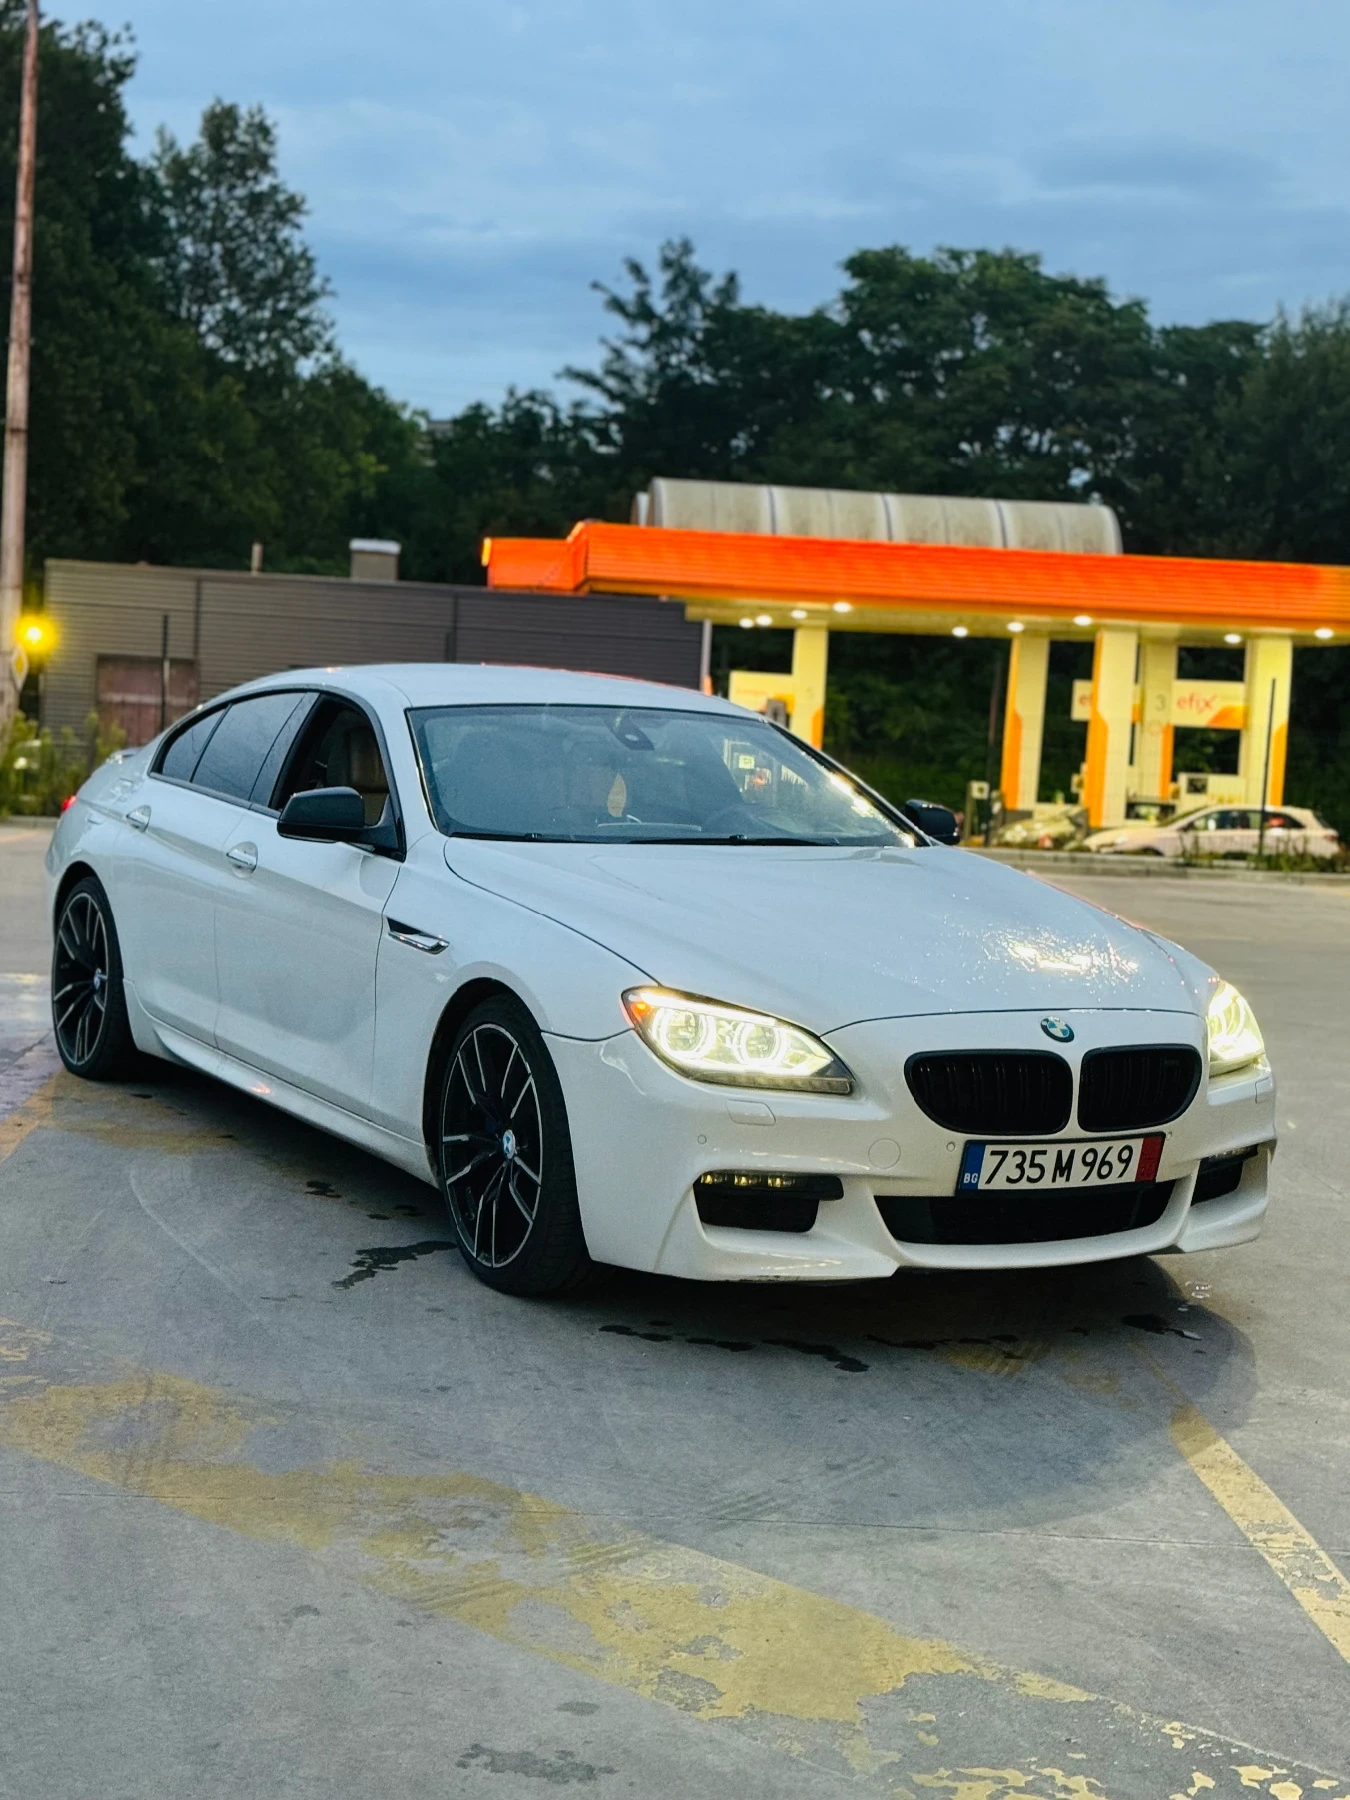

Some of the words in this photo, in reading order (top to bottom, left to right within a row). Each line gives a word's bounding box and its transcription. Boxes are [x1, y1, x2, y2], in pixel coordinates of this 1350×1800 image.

[1155, 694, 1167, 711] 3
[984, 1149, 1048, 1185] 735
[1051, 1148, 1076, 1183] M
[1081, 1144, 1134, 1182] 969
[963, 1172, 979, 1184] BG
